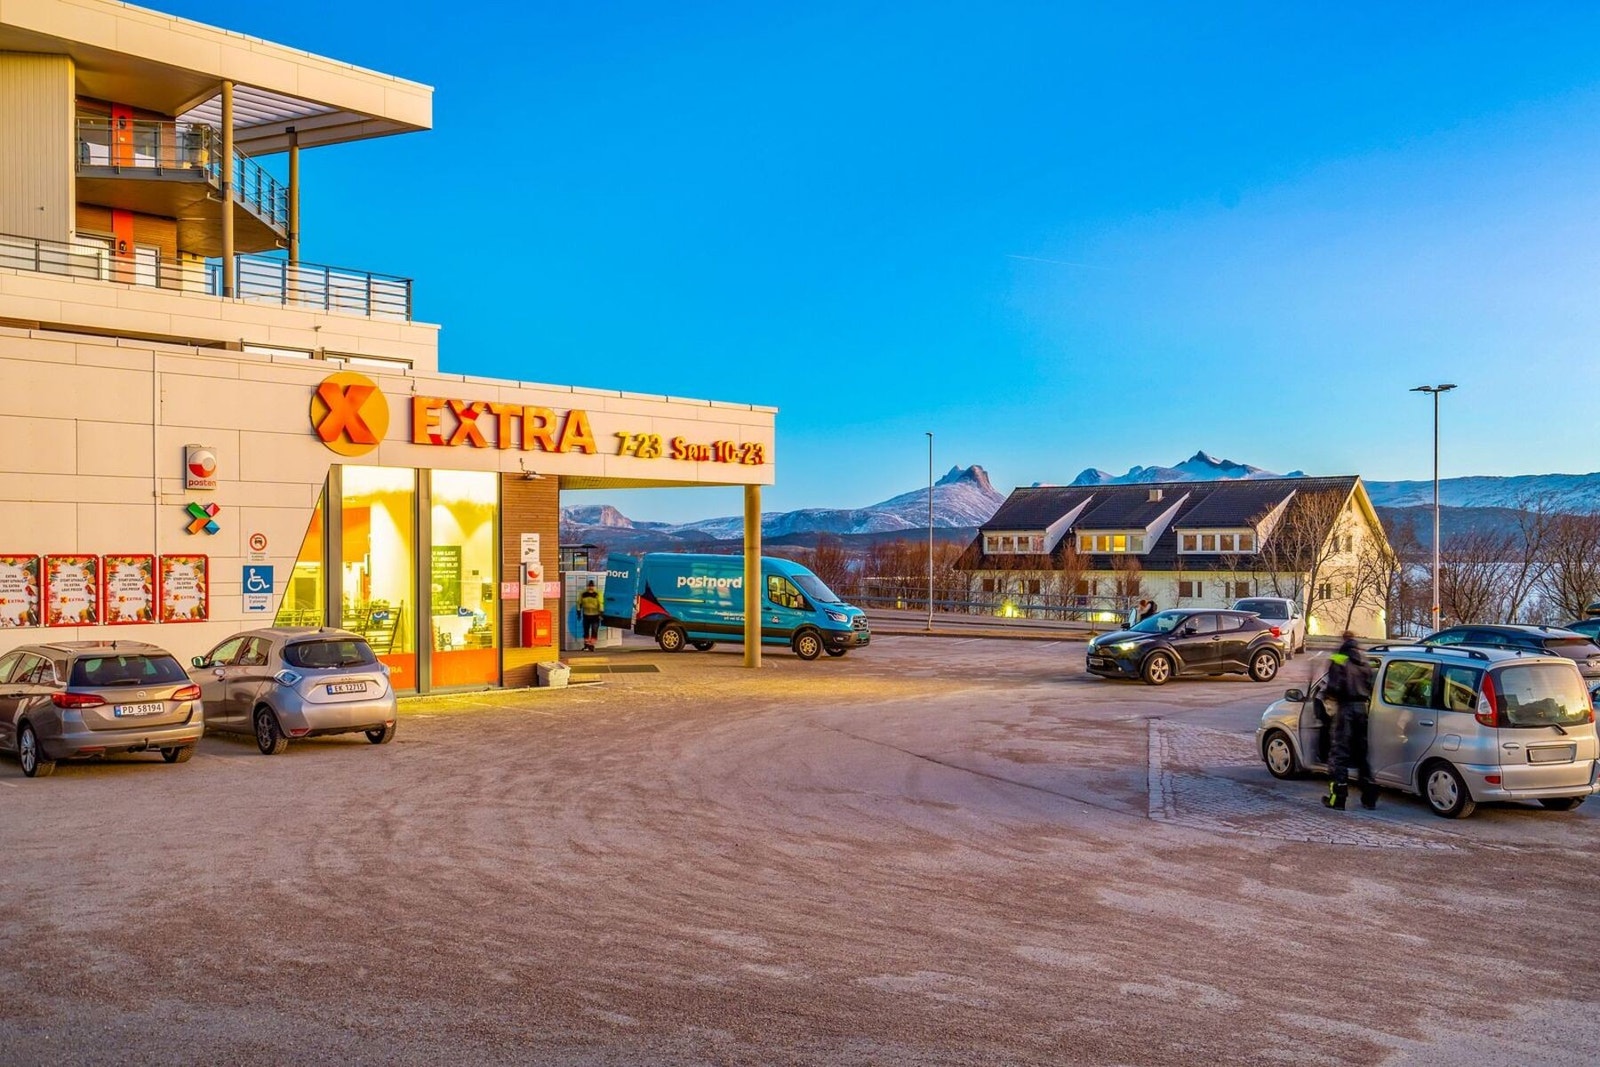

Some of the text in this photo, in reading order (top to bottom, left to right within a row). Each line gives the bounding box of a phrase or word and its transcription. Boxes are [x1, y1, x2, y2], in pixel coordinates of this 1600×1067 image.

[411, 395, 598, 454] EXTRA
[614, 431, 662, 458] 7-23
[712, 440, 765, 465] 10-23
[188, 479, 216, 487] posten
[677, 575, 742, 588] postnord
[122, 703, 162, 714] PD 58194
